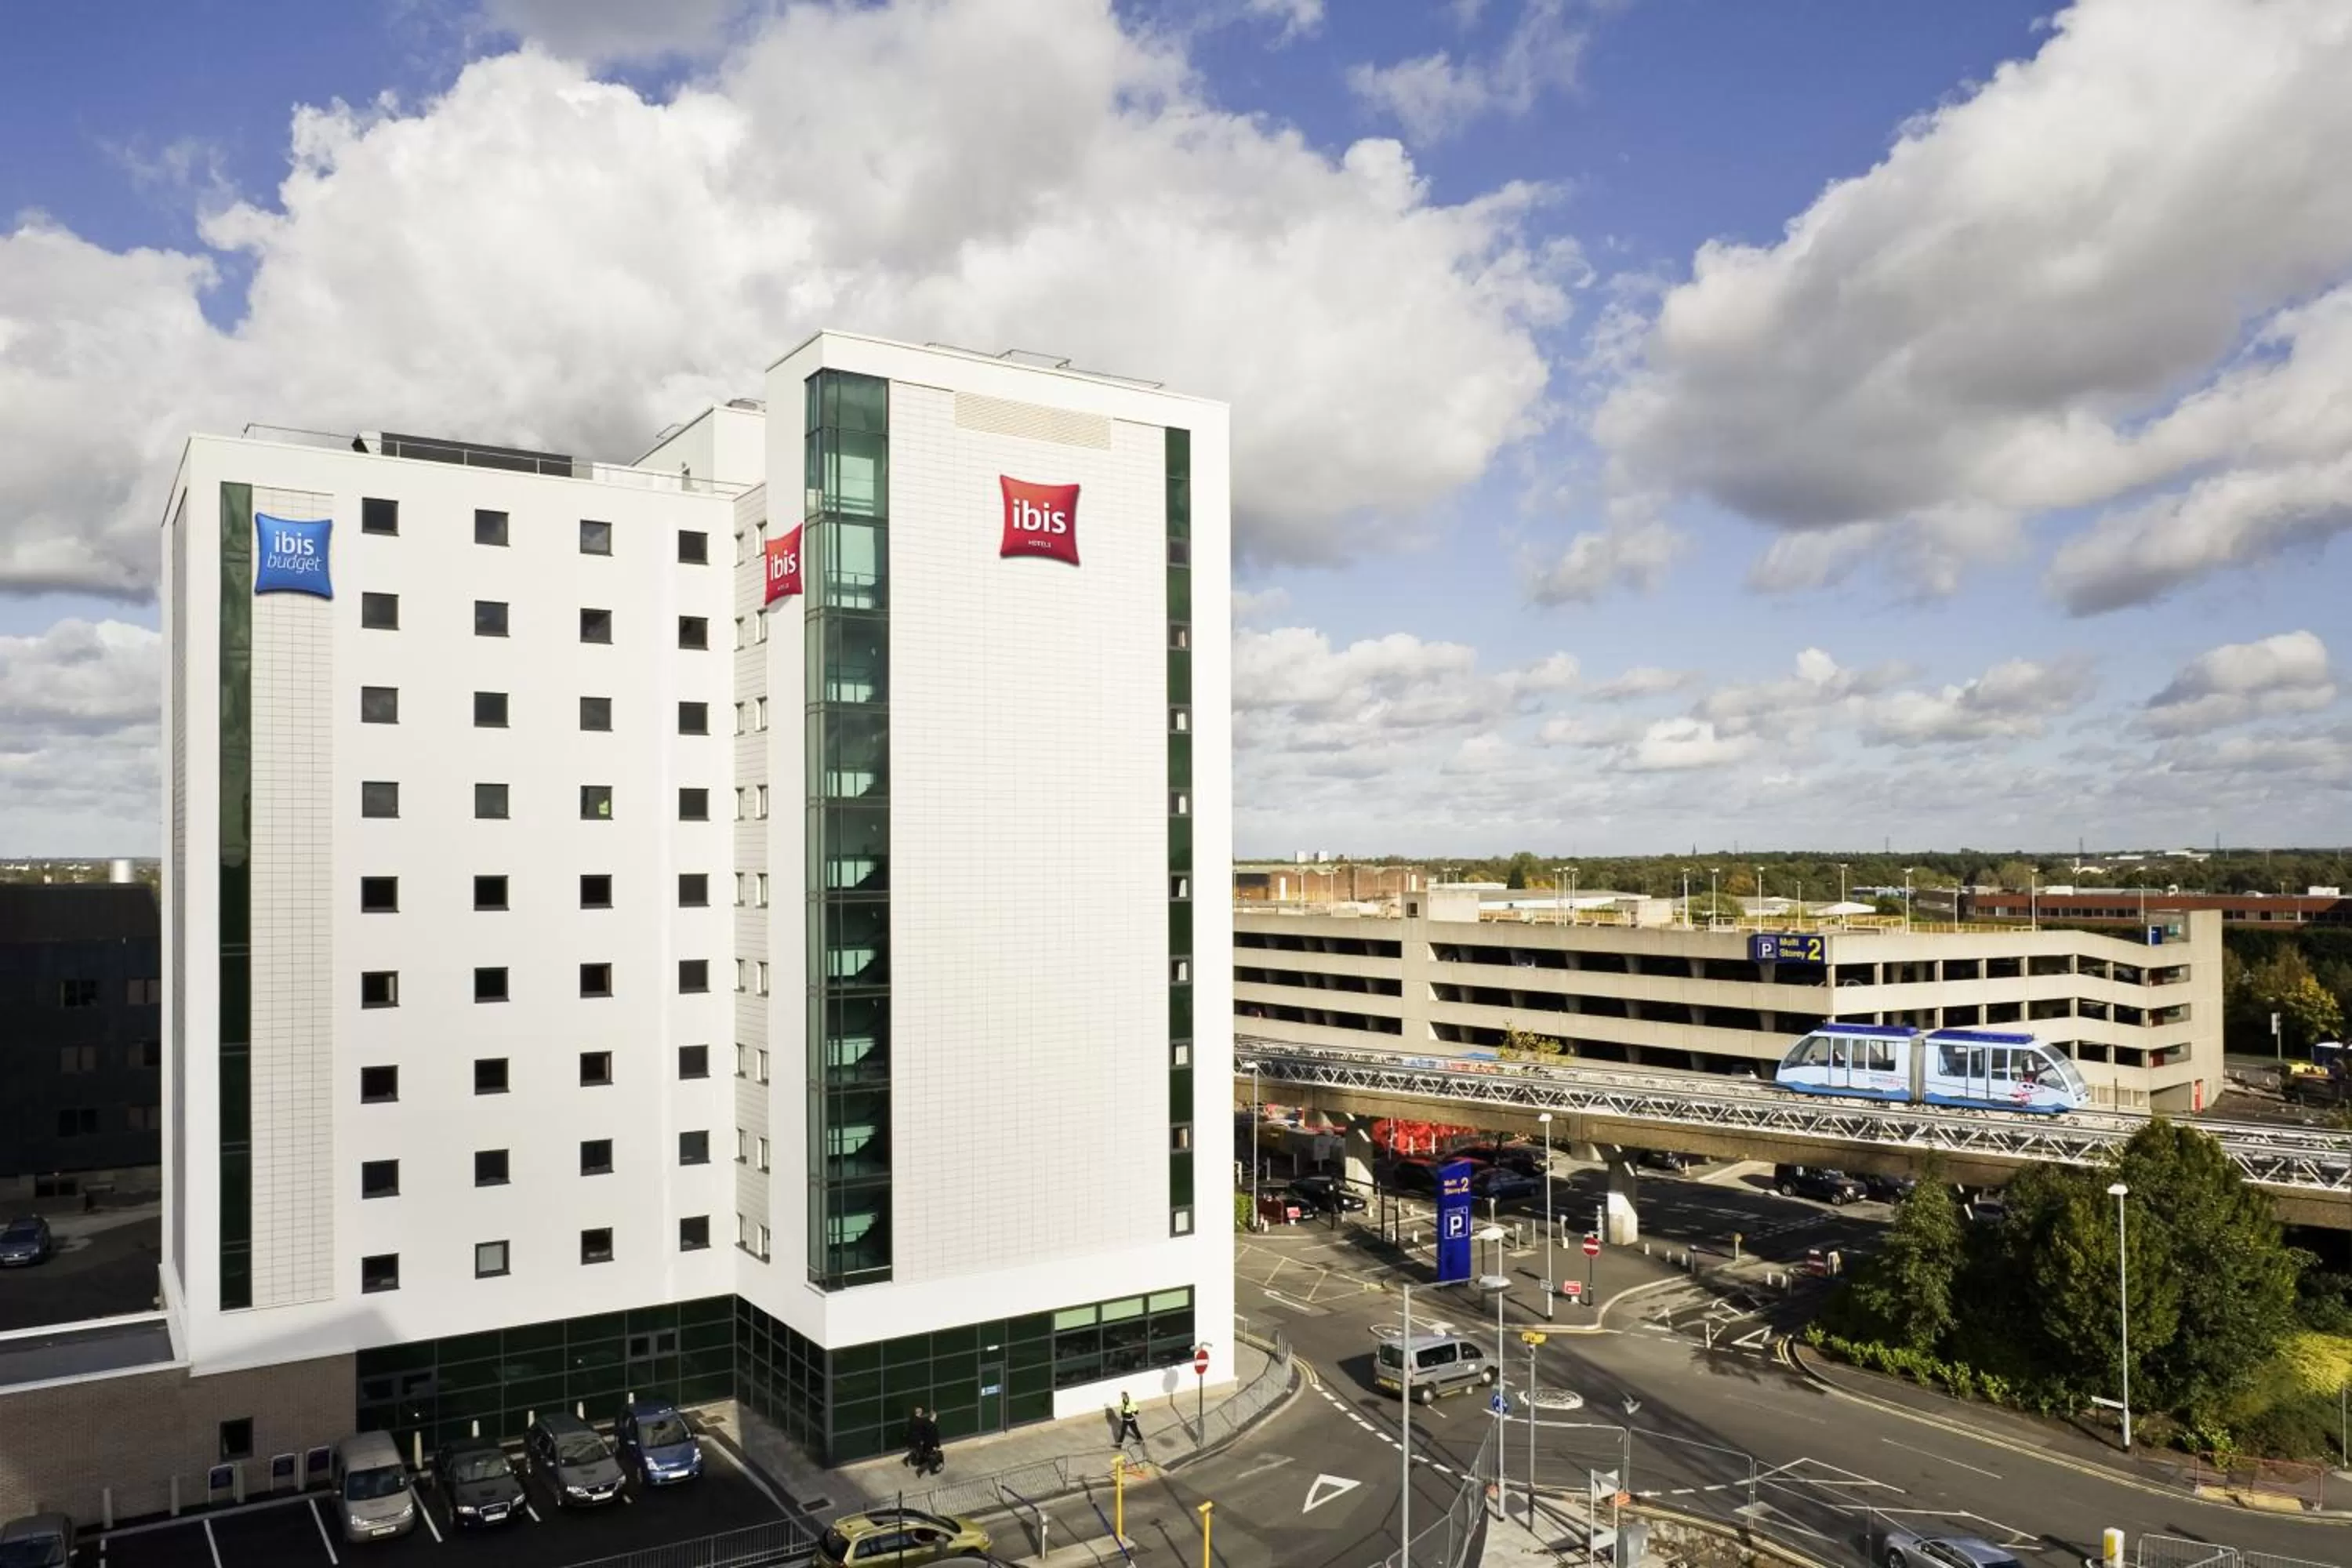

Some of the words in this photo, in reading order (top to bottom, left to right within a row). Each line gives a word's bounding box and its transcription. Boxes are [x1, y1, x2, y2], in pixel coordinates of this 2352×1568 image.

[1013, 498, 1066, 534] ibis
[275, 530, 314, 555] ibis
[267, 551, 322, 574] budget
[771, 549, 796, 581] ibis
[1779, 936, 1799, 946] Multi
[1808, 938, 1821, 960] 2
[1779, 948, 1806, 960] Storey
[1461, 1177, 1469, 1192] 2
